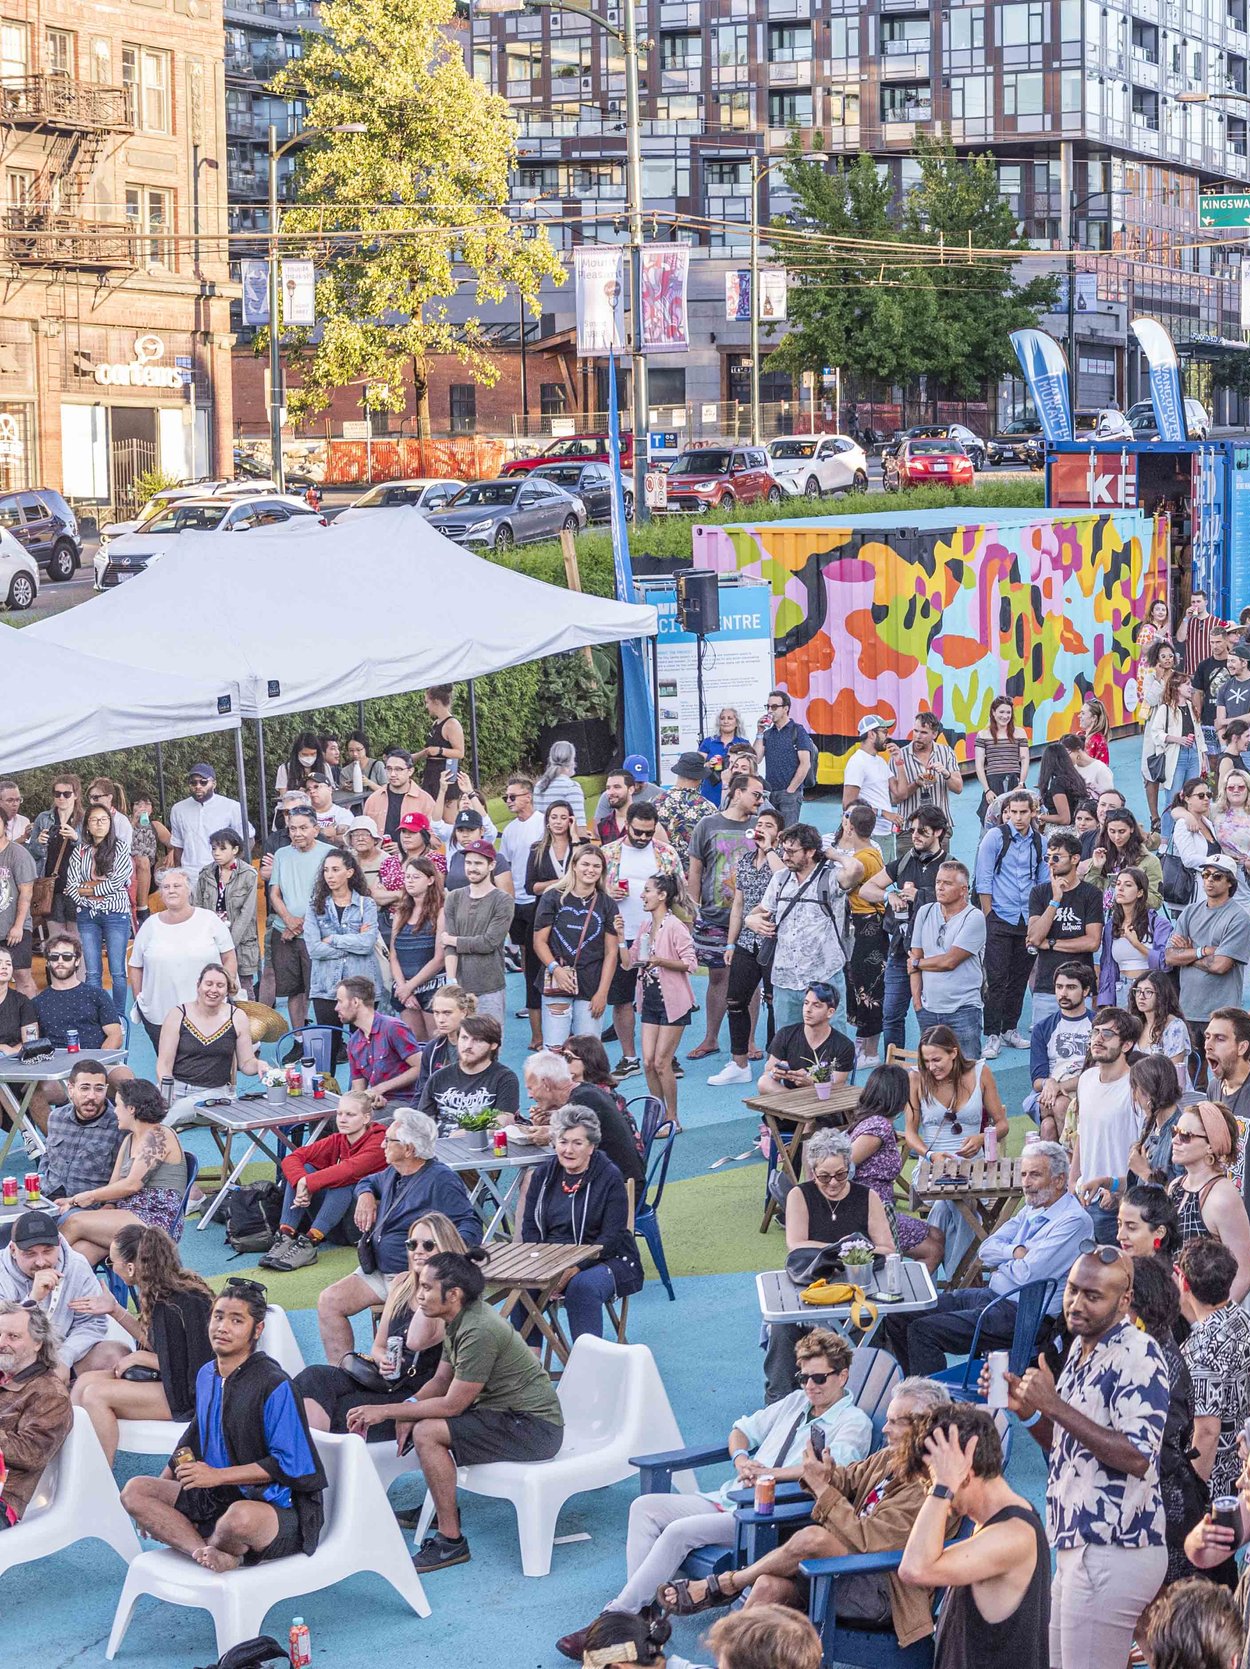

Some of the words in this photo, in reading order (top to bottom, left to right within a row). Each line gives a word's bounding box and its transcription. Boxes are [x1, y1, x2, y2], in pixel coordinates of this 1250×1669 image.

[1037, 381, 1058, 426] MURAL
[1160, 363, 1182, 441] VANCOUVER
[719, 614, 761, 630] ENTRE
